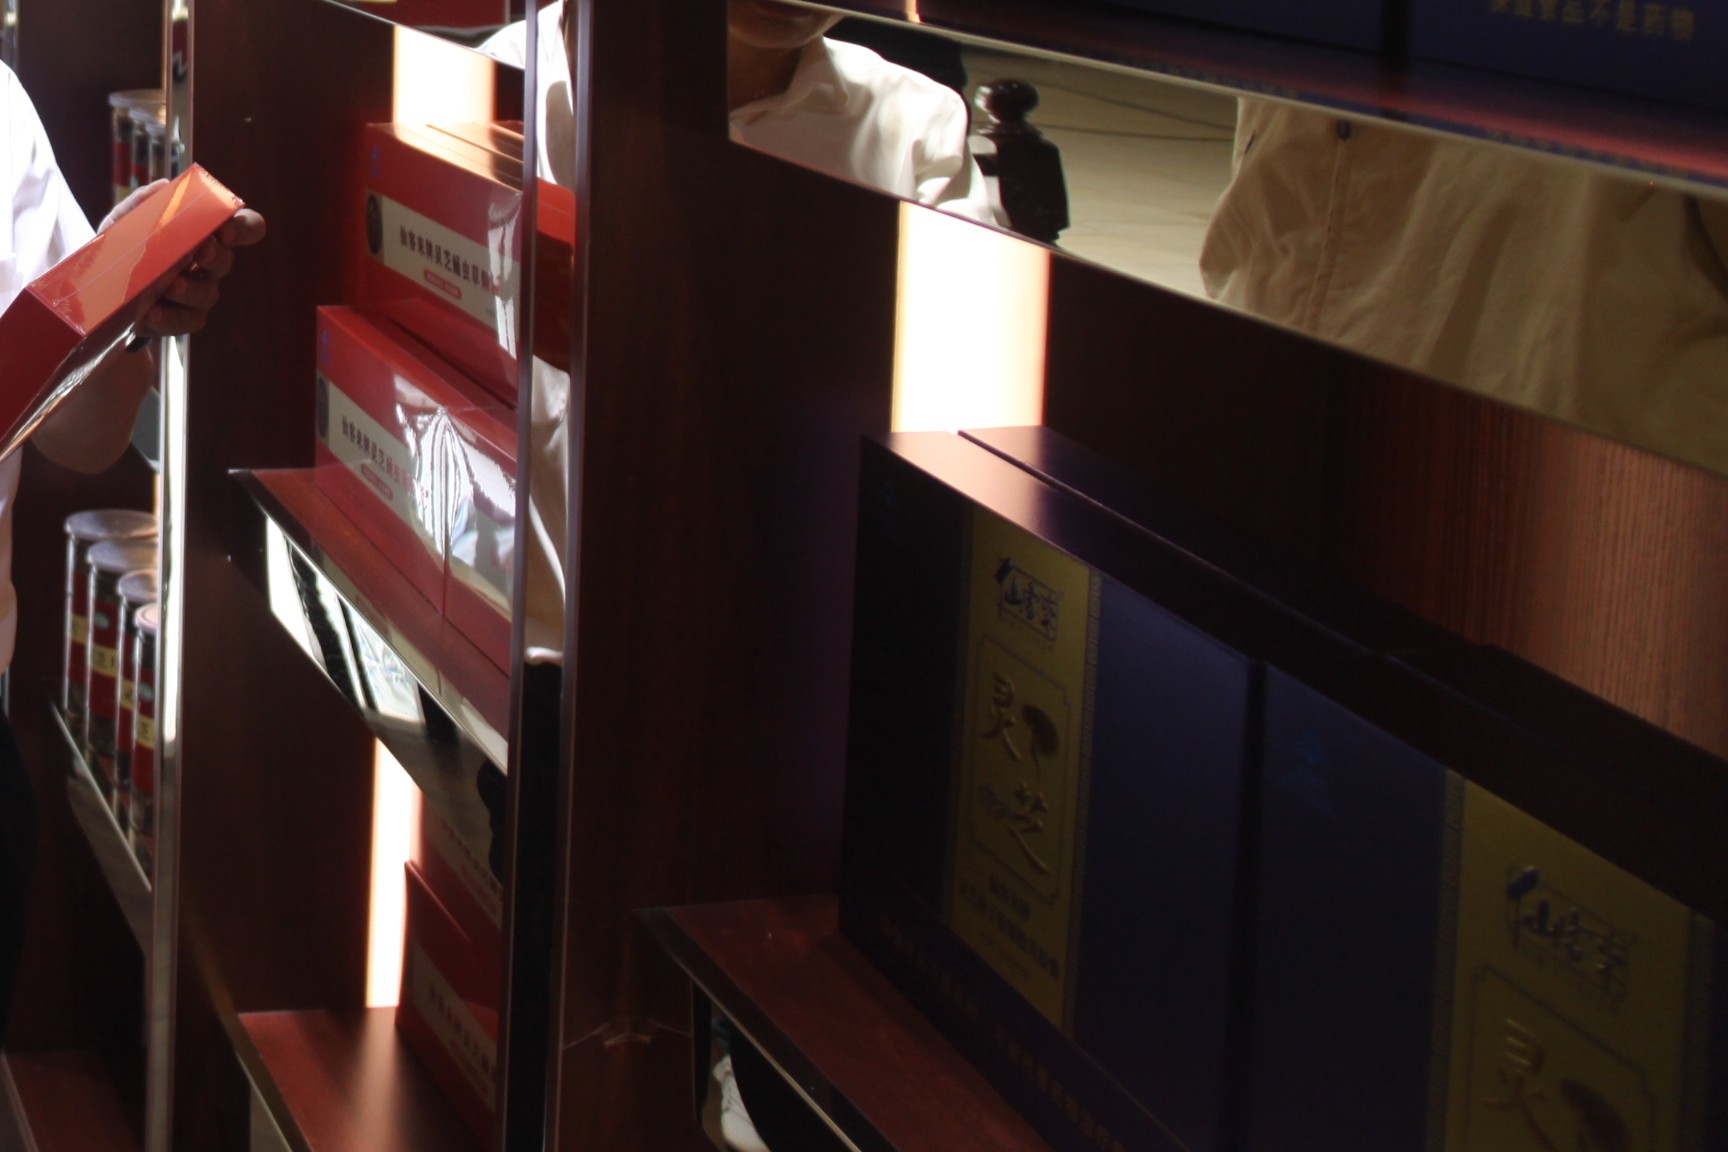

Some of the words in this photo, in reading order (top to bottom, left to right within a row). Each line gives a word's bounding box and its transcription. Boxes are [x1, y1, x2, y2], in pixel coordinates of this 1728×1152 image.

[400, 225, 498, 295] 仙客来牌灵芝蛹虫草颗
